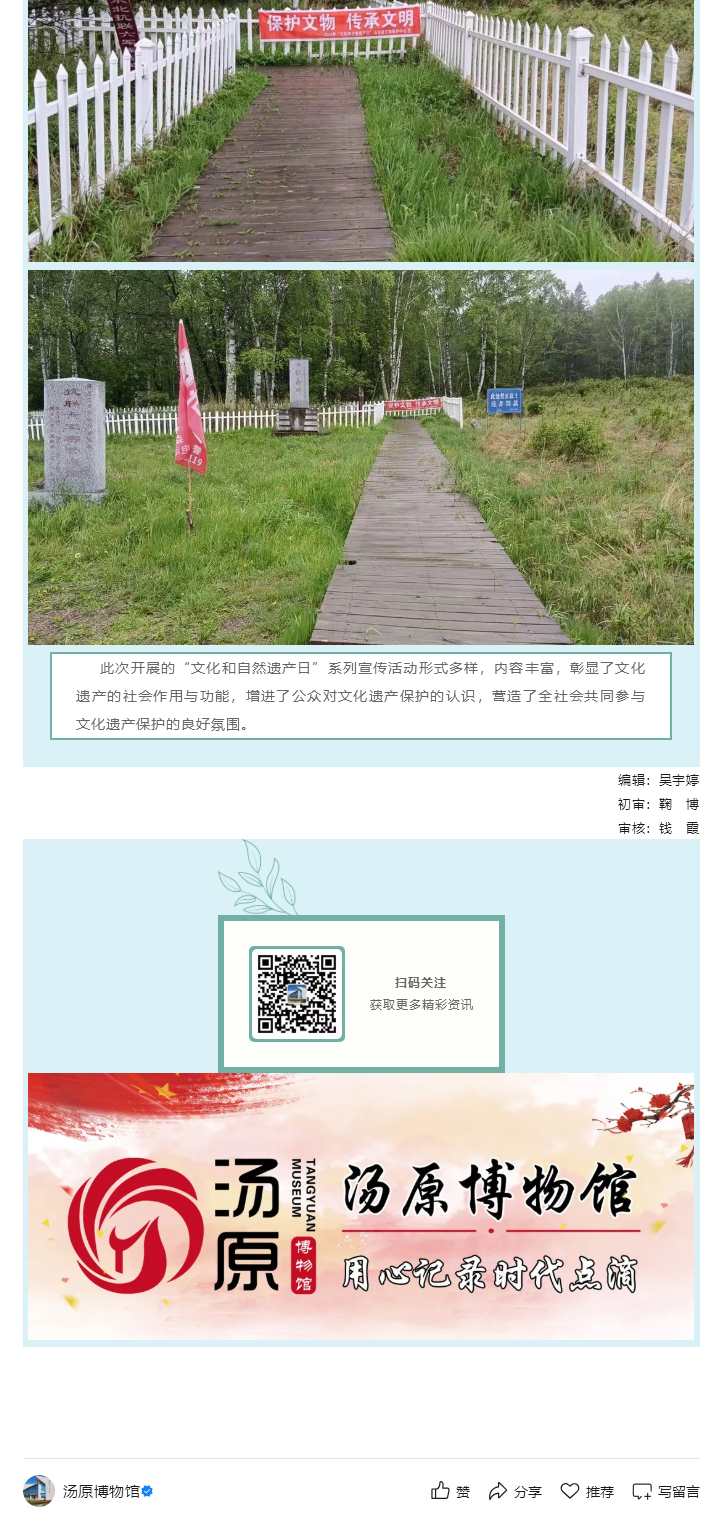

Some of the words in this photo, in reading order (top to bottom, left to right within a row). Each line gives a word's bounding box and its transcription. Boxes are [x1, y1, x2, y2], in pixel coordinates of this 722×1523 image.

[267, 14, 336, 32] 保护文物
[346, 9, 414, 30] 传承文明
[76, 717, 247, 732] 文化遗产保护的良好氛围。
[686, 798, 700, 810] 博
[686, 822, 700, 834] 霞
[394, 977, 447, 989] 扫码关注
[369, 999, 474, 1011] 获取更多精彩资讯
[291, 1158, 301, 1218] MUSEUM
[306, 1158, 316, 1232] TANGYUAN
[344, 1158, 638, 1221] 汤原博物馆
[295, 1240, 313, 1291] 博物馆
[342, 1254, 638, 1294] 用心记录时代点滴
[63, 1484, 140, 1499] 汤原博物馆
[456, 1485, 470, 1499] 赞
[514, 1485, 542, 1499] 分享
[586, 1485, 614, 1499] 推荐
[658, 1485, 700, 1499] 写留言
